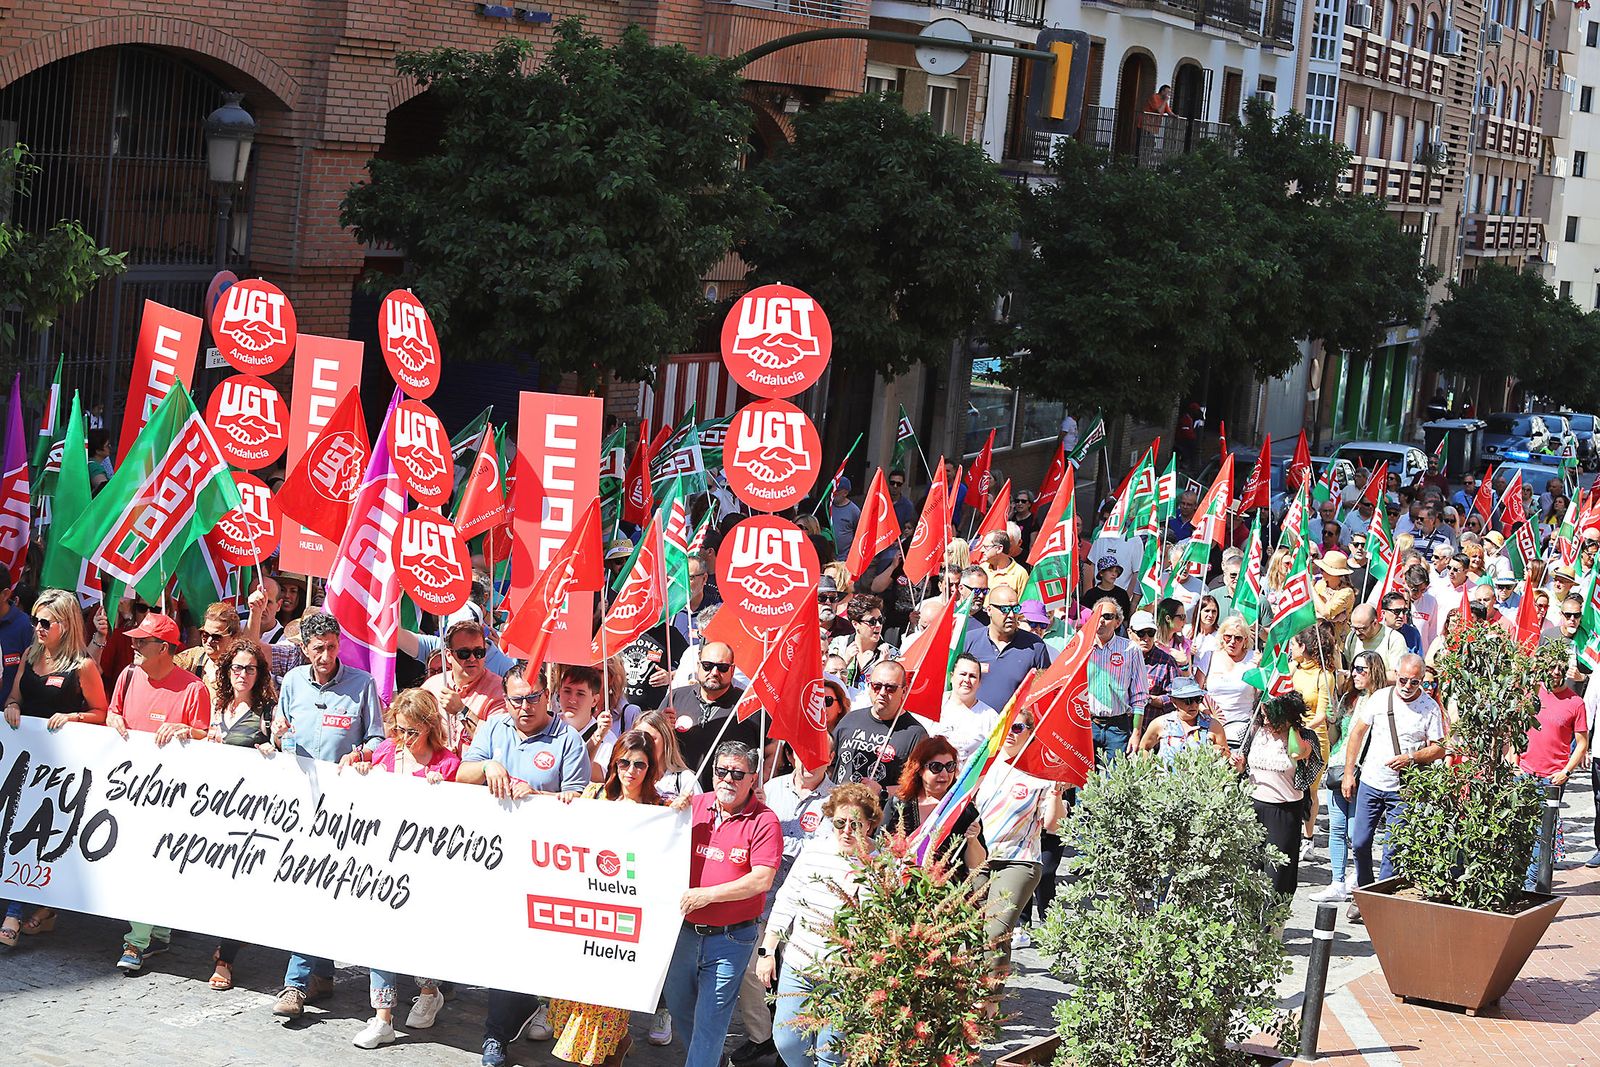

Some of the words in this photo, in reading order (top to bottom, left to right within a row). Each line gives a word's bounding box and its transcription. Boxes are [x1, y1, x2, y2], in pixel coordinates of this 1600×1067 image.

[224, 286, 285, 328] UGT
[386, 298, 427, 347] UGT
[738, 297, 814, 340] UGT
[229, 347, 274, 365] Andalucía
[398, 368, 430, 388] Andalucía
[746, 369, 805, 386] Andalucía
[219, 381, 279, 423] UGT
[395, 407, 440, 457] UGT
[738, 410, 806, 454] UGT
[224, 442, 270, 459] Andalucía
[312, 435, 355, 488] UGT
[232, 482, 271, 520] GT
[406, 477, 442, 495] Andalucía
[744, 482, 797, 499] Andalucía
[299, 540, 324, 552] HUELVA
[400, 517, 457, 564] UGT
[731, 526, 804, 570] UGT
[413, 585, 456, 604] Andalucía
[739, 598, 794, 616] Andalucía
[29, 764, 66, 791] DE
[106, 760, 187, 808] Subir
[309, 793, 381, 851] bajar
[389, 819, 503, 871] precios
[152, 829, 279, 880] repartir
[273, 838, 411, 910] beneficios
[531, 839, 591, 873] UGT
[4, 861, 51, 890] 2023
[588, 877, 637, 896] Huelva
[583, 939, 636, 962] Huelva
